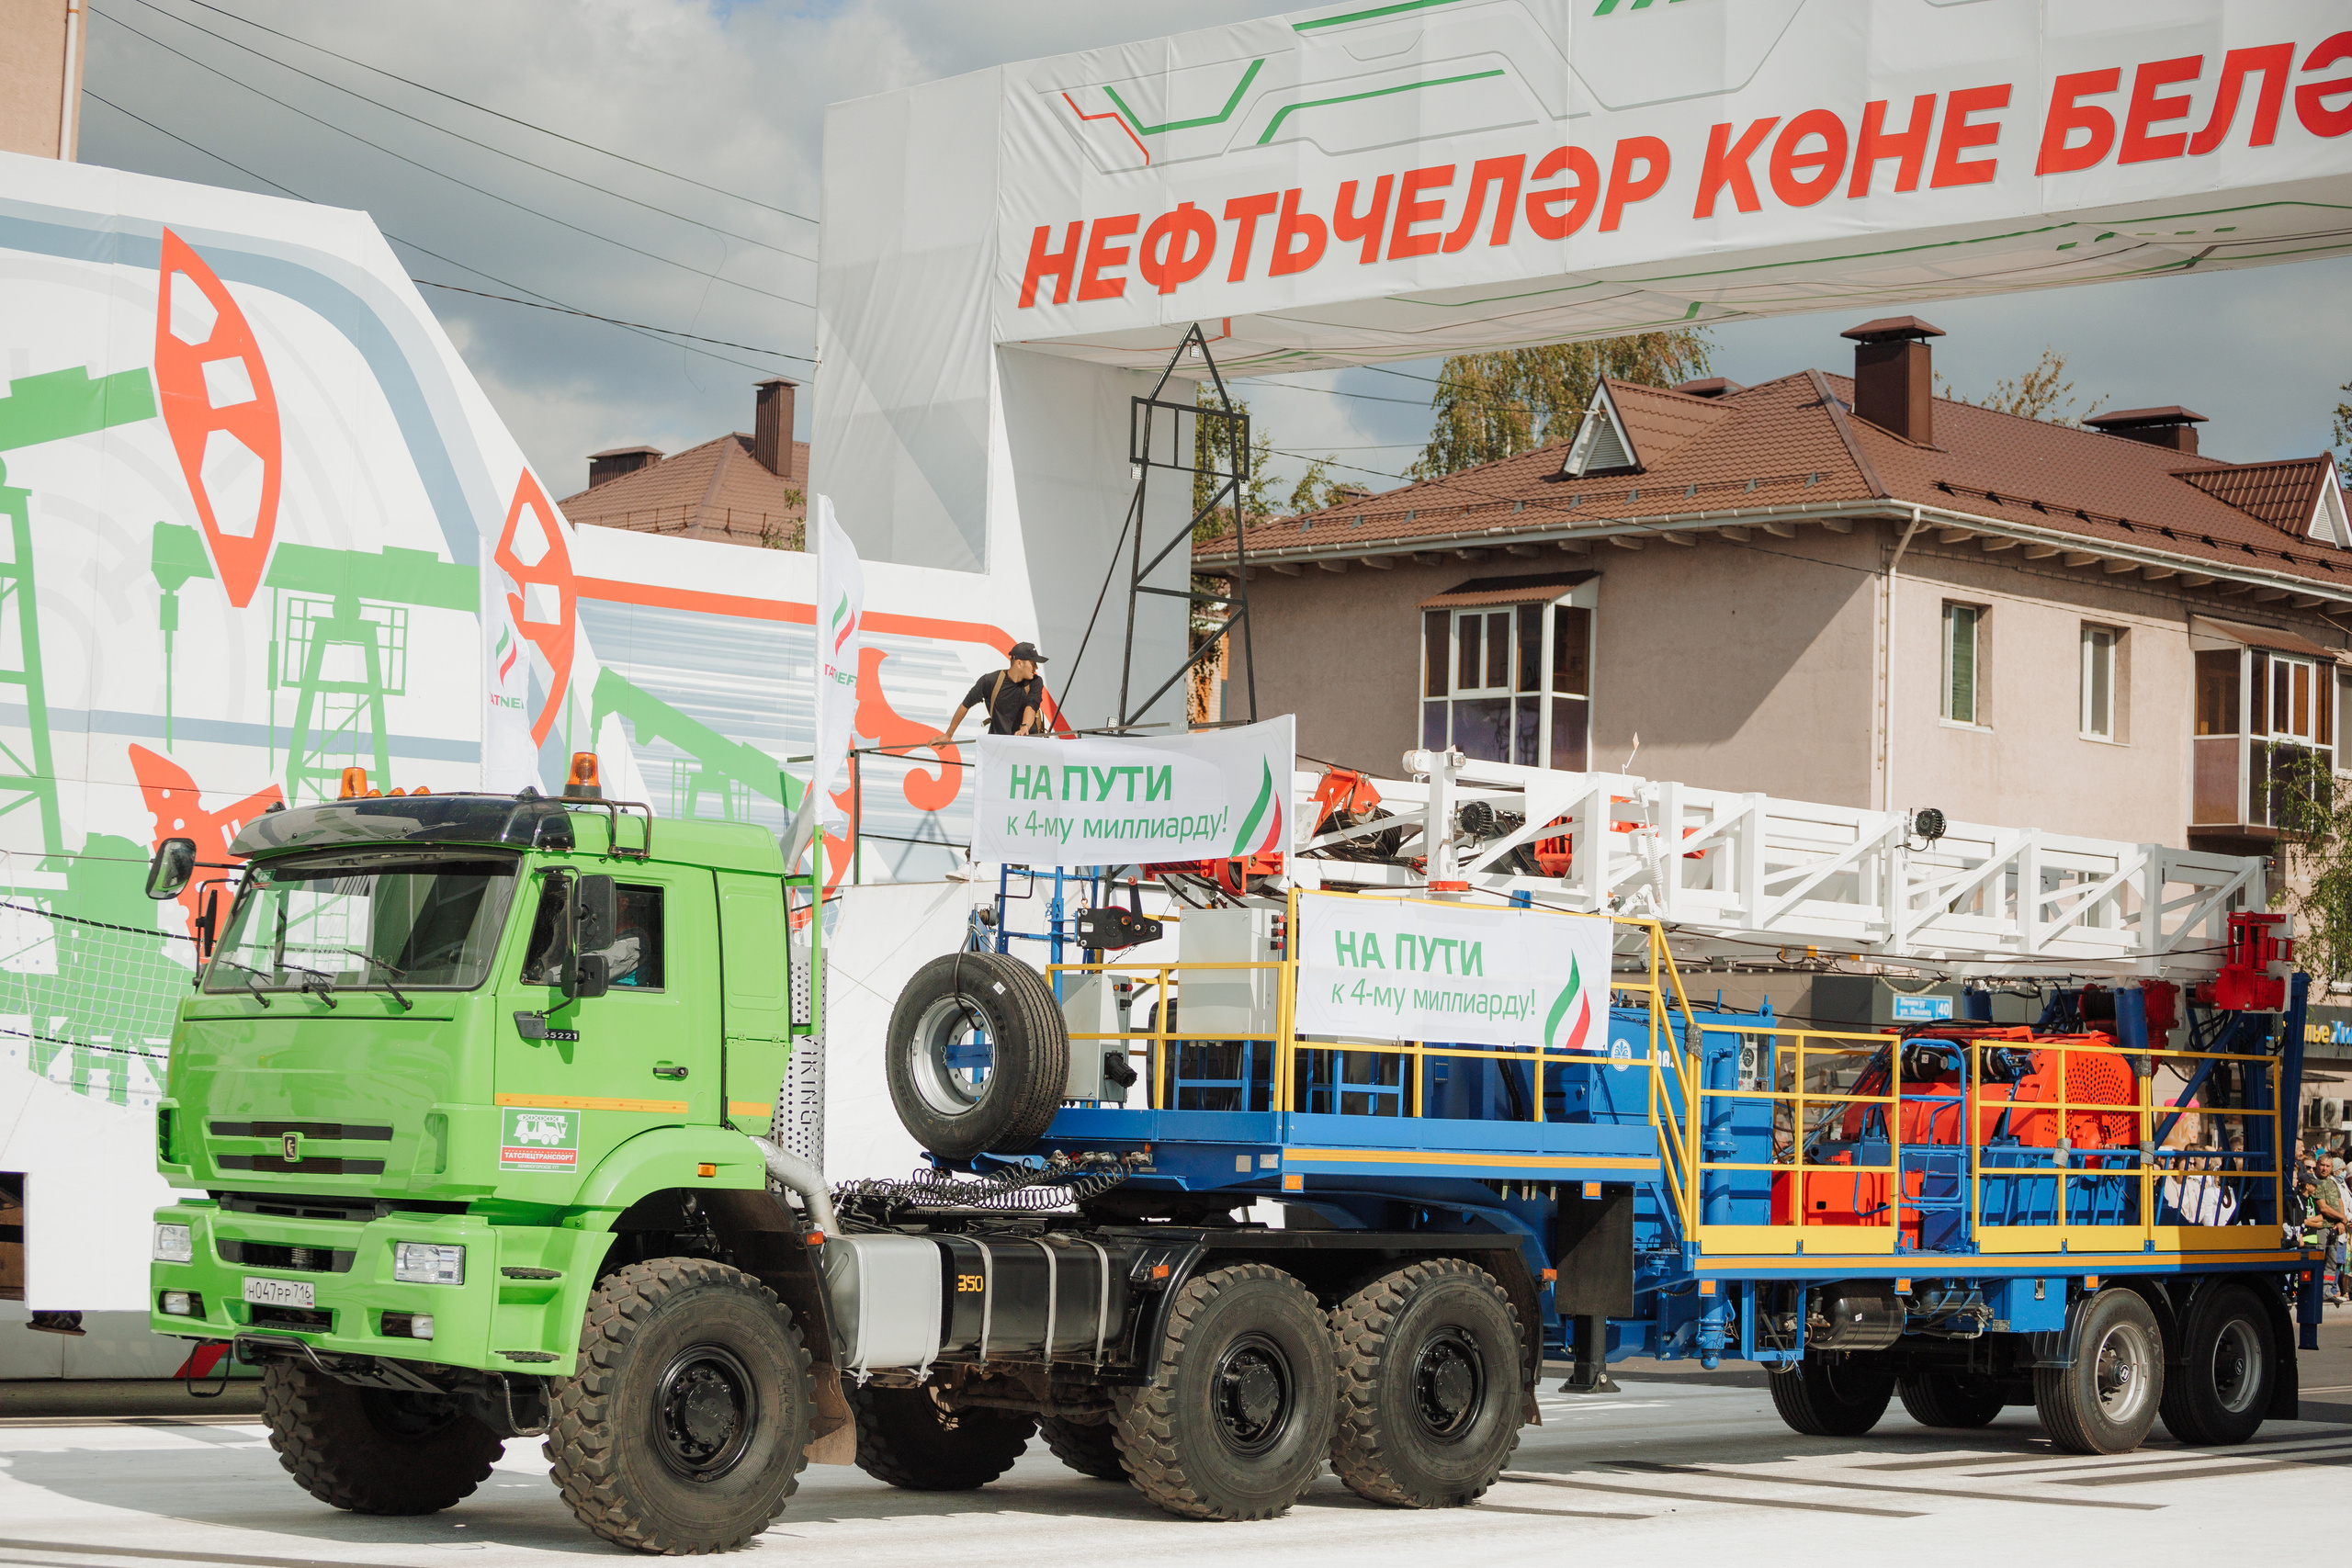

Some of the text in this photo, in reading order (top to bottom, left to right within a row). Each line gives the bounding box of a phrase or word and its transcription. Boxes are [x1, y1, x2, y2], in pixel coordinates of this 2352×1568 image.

[1018, 135, 1671, 310] НЕФТЬЧЕЛӘР
[1692, 83, 2013, 220] КӨНЕ
[1009, 763, 1172, 802] НА ПУТИ
[1006, 805, 1229, 845] к 4-му миллиарду!
[1334, 930, 1484, 977] НА ПУТИ
[1331, 977, 1536, 1022] к 4-му миллиарду!
[1938, 1002, 1950, 1016] 40
[801, 1034, 819, 1124] VIKING
[504, 1152, 574, 1161] ТАТСПЕЦТРАНСПОРТ
[294, 1283, 311, 1299] 716
[957, 1274, 984, 1292] 350
